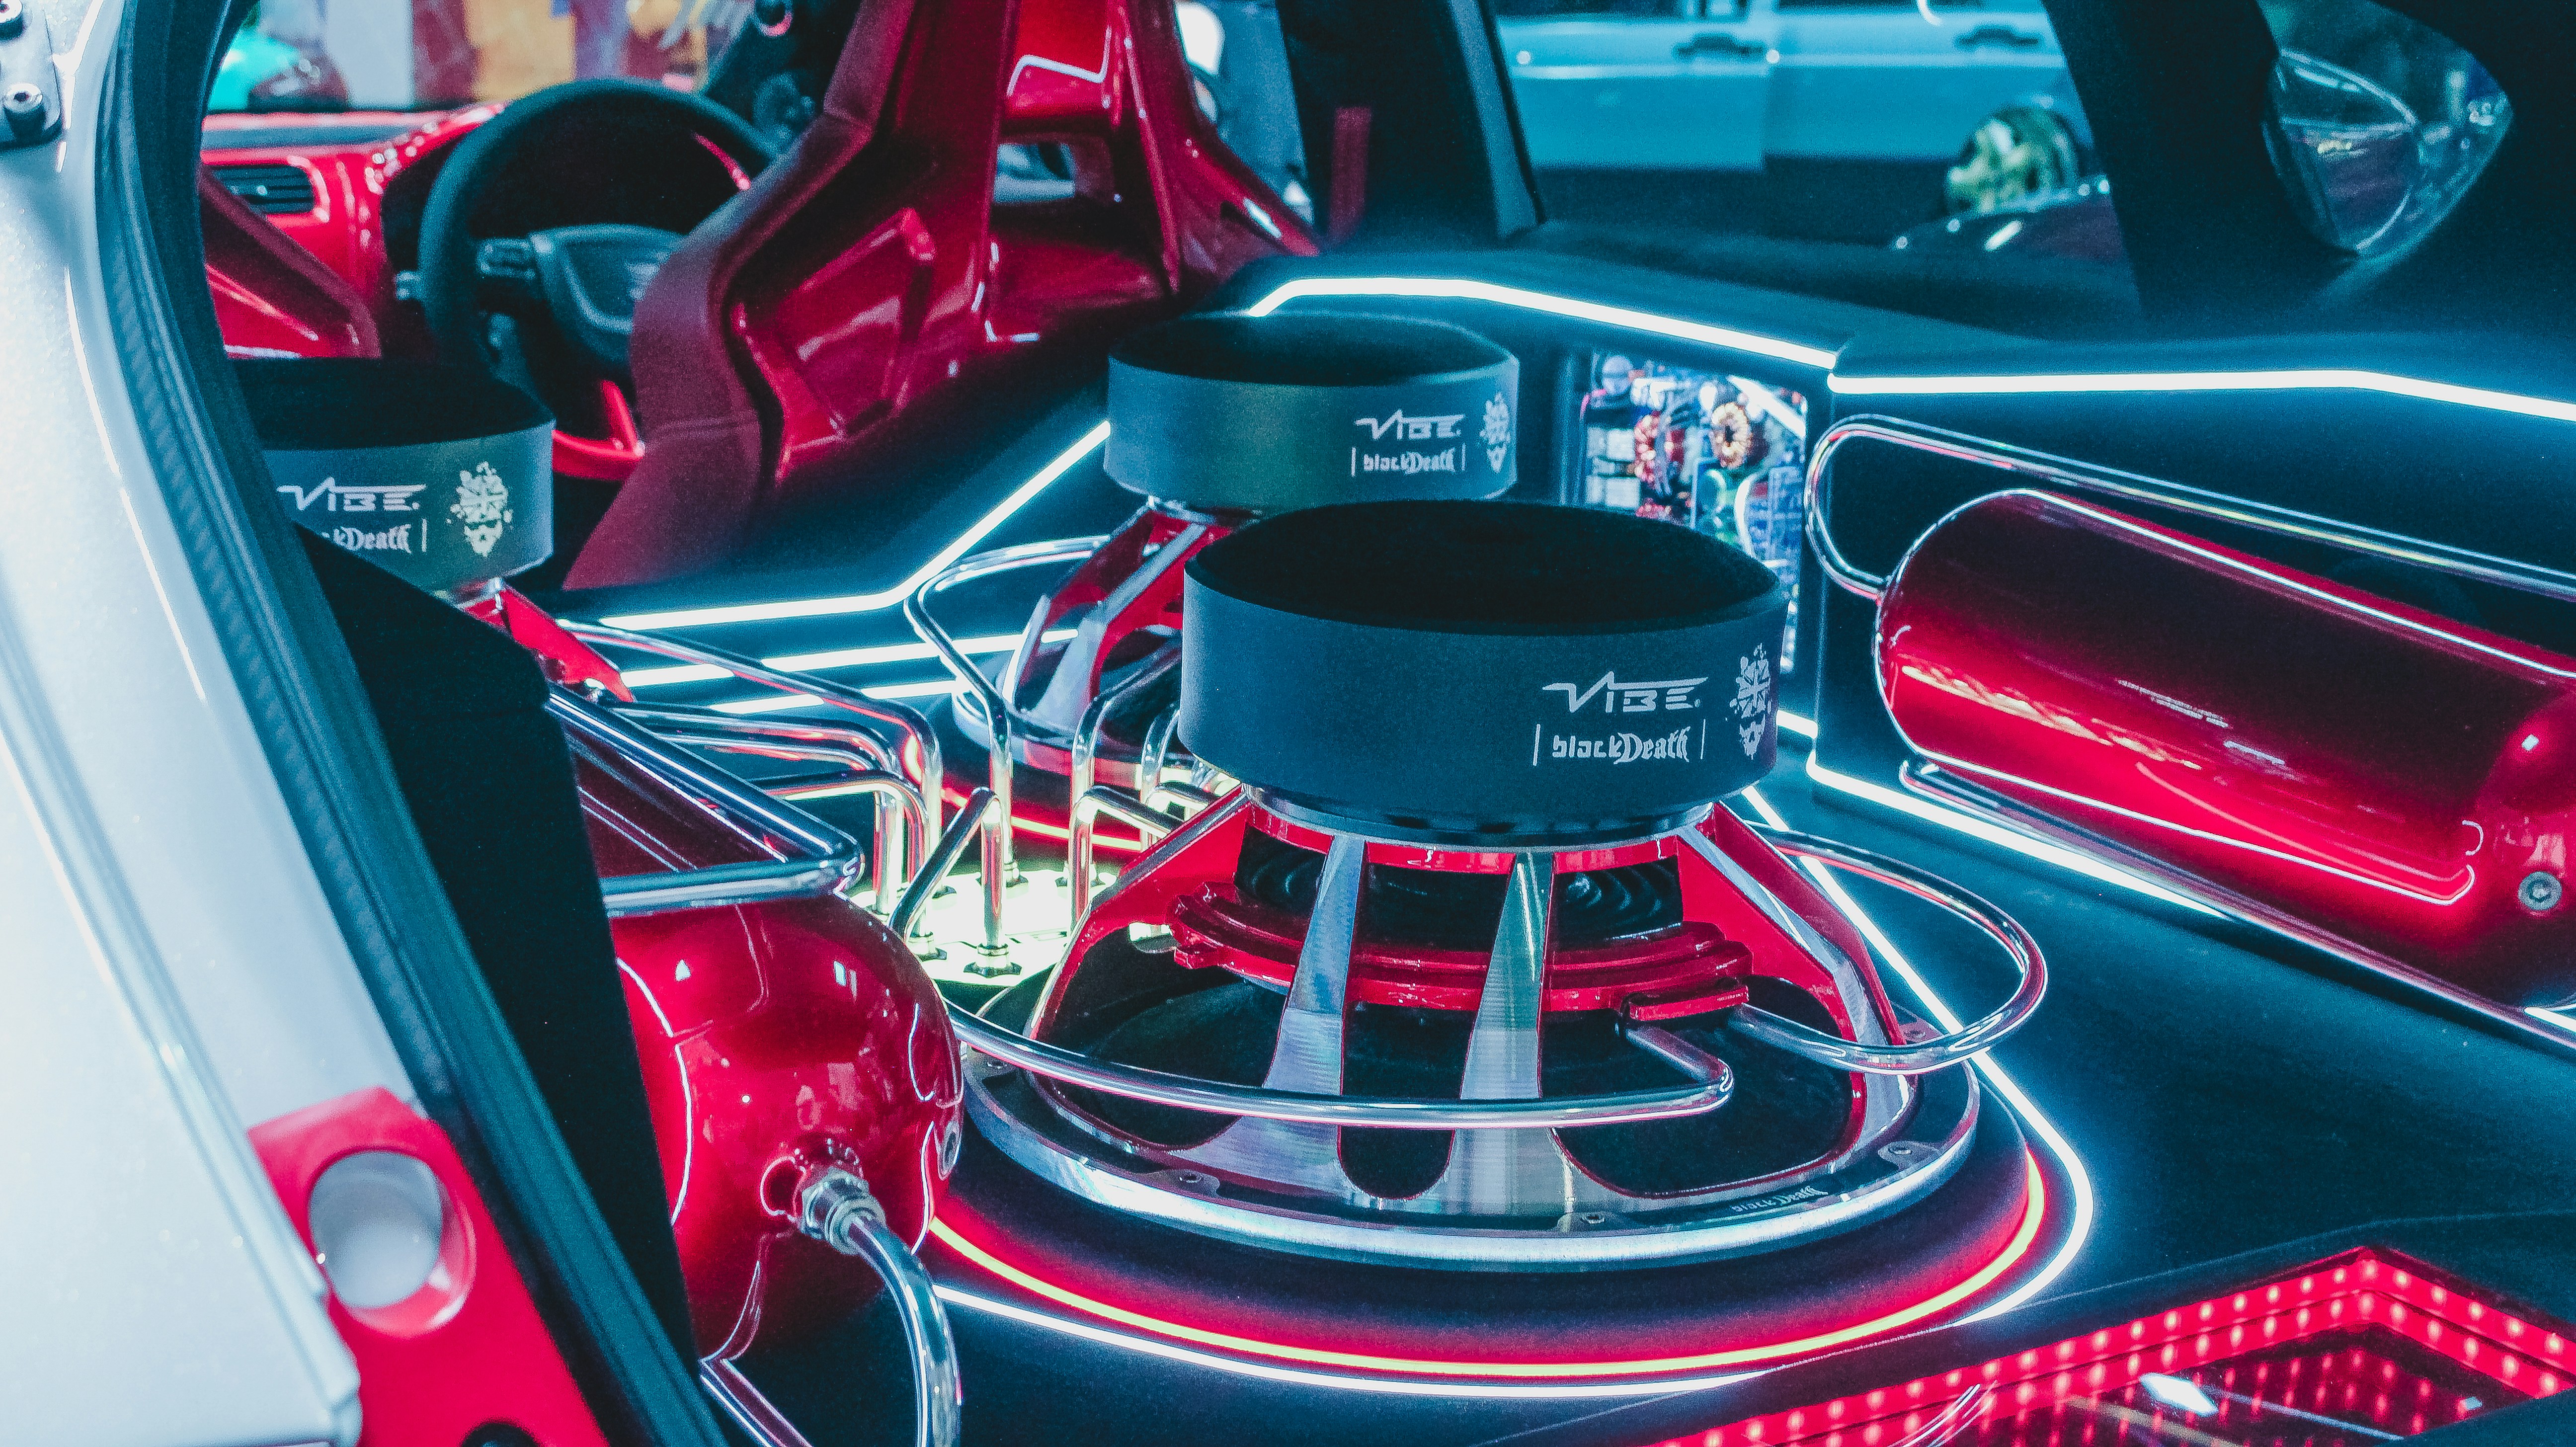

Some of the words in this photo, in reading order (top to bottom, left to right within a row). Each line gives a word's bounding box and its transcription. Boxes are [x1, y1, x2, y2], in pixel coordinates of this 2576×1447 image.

[1356, 409, 1465, 440] VIBE
[277, 477, 426, 511] VIBE
[1542, 671, 1708, 713] VIBE
[1552, 725, 1691, 764] blackDeath
